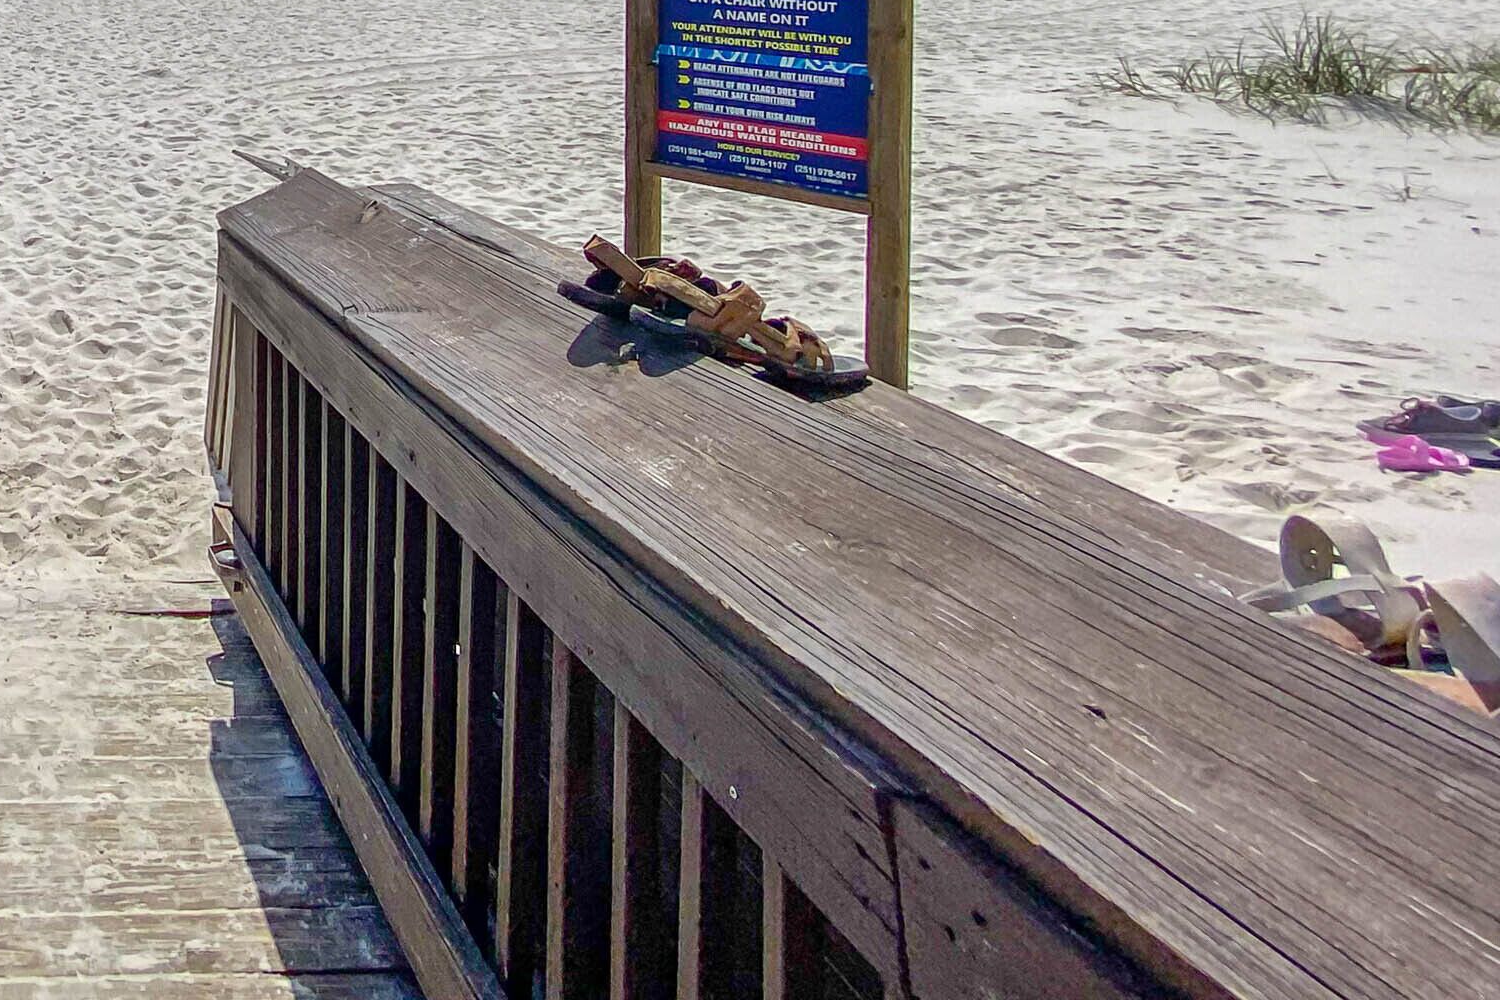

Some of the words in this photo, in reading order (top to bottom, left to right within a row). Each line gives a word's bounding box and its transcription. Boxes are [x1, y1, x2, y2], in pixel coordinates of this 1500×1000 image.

[769, 0, 837, 13] WITHOUT
[713, 10, 723, 20] A
[725, 10, 767, 23] NAME
[770, 13, 793, 24] ON
[794, 15, 809, 26] IT
[672, 22, 697, 31] YOUR
[699, 24, 757, 37] ATTENDANT
[757, 28, 782, 39] WILL
[784, 31, 796, 40] BE
[798, 33, 826, 43] WITH
[829, 36, 852, 45] YOU
[682, 33, 693, 41] IN
[695, 36, 713, 44] THE
[715, 37, 763, 48] SHORTEST
[765, 41, 811, 51] POSSIBLE
[812, 46, 839, 55] TIME
[693, 62, 716, 72] BEACH
[764, 70, 780, 78] ARE
[798, 72, 845, 87] LIFEGUARDS
[731, 91, 748, 101] SAFE
[753, 83, 776, 94] FLAGS
[777, 86, 797, 97] DOES
[725, 105, 746, 116] YOUR
[697, 119, 719, 127] ANY
[723, 122, 744, 130] RED
[748, 124, 777, 136] FLAG
[780, 130, 822, 142] MEANS
[669, 121, 734, 137] HAZARDOUS
[737, 132, 777, 145] WATER
[780, 138, 857, 156] CONDITIONS
[668, 145, 687, 155] (251)
[717, 143, 735, 151] HOW
[745, 147, 762, 155] OUR
[729, 154, 749, 166] (251)
[795, 165, 816, 175] (251)
